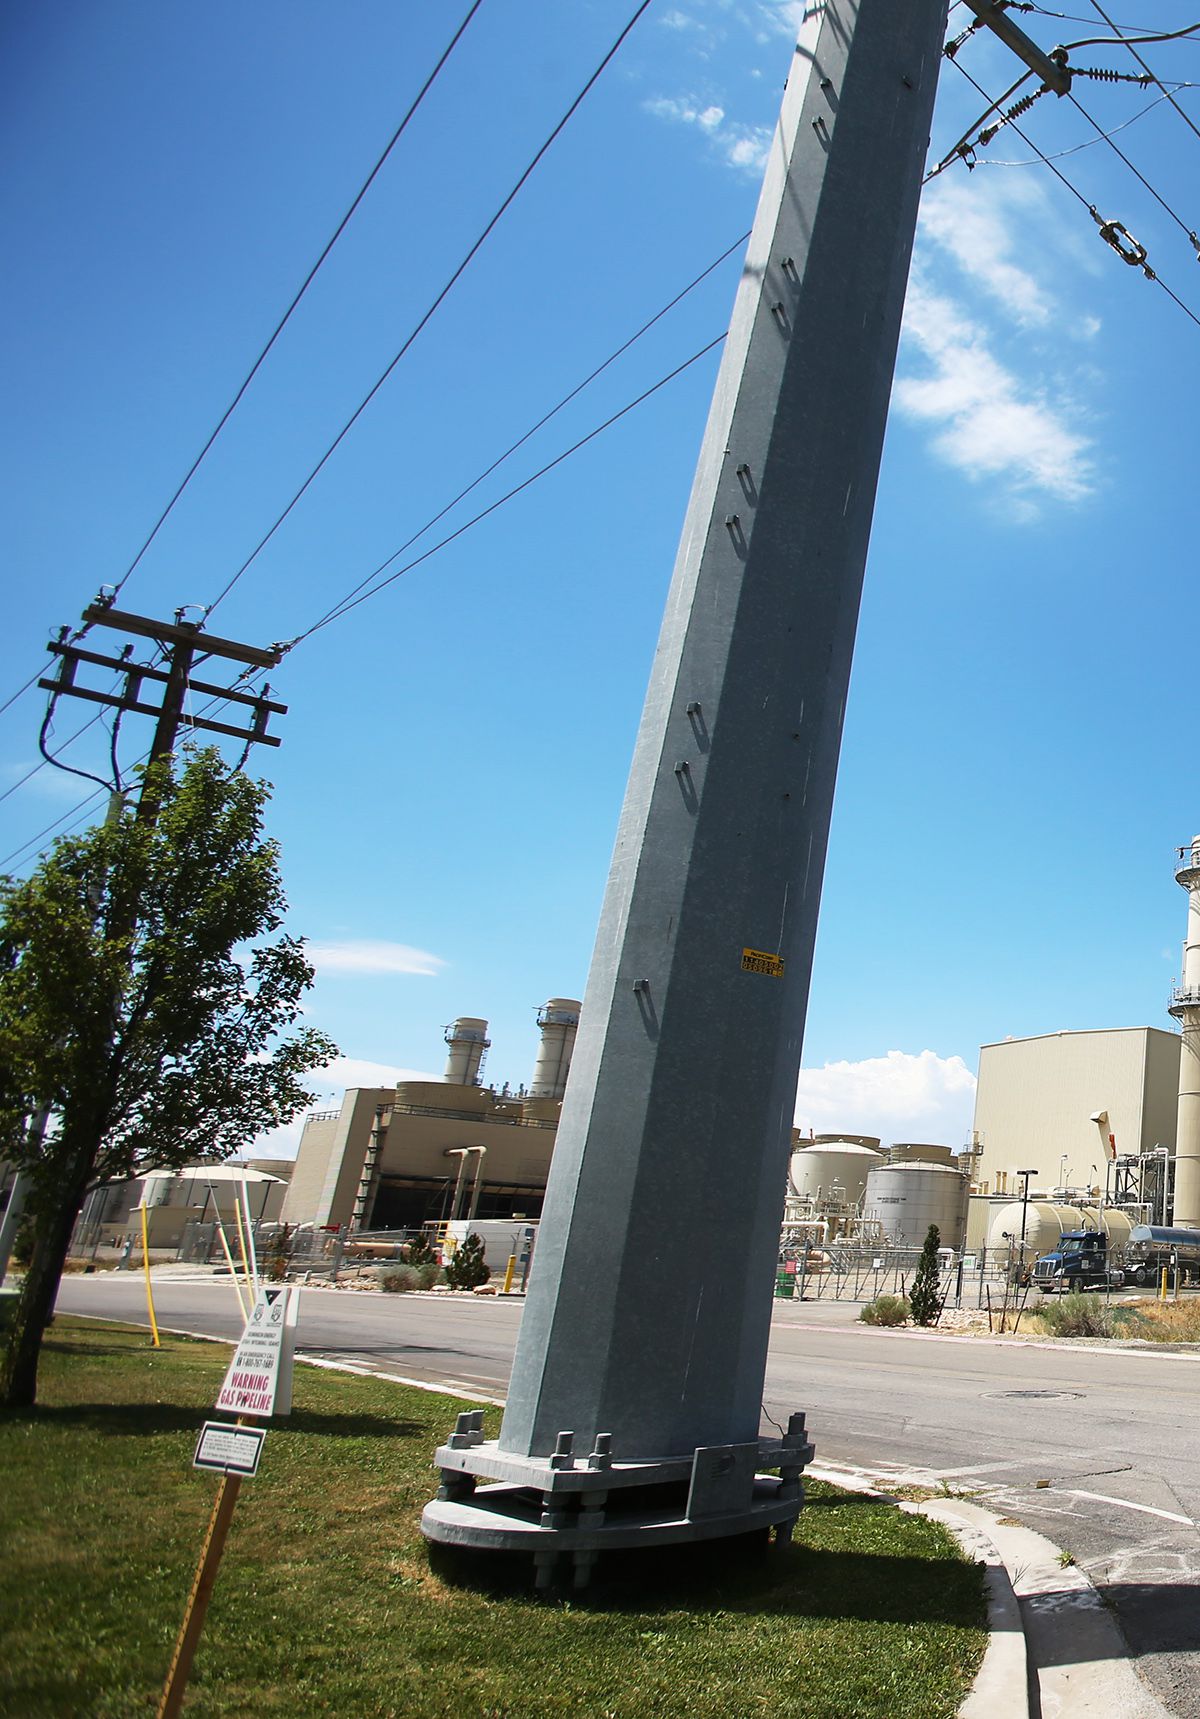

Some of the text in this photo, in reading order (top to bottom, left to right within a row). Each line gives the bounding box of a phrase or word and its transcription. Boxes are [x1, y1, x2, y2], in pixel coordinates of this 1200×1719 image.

[231, 1372, 270, 1391] WARNING
[220, 1388, 273, 1410] GAS PIPELINE
